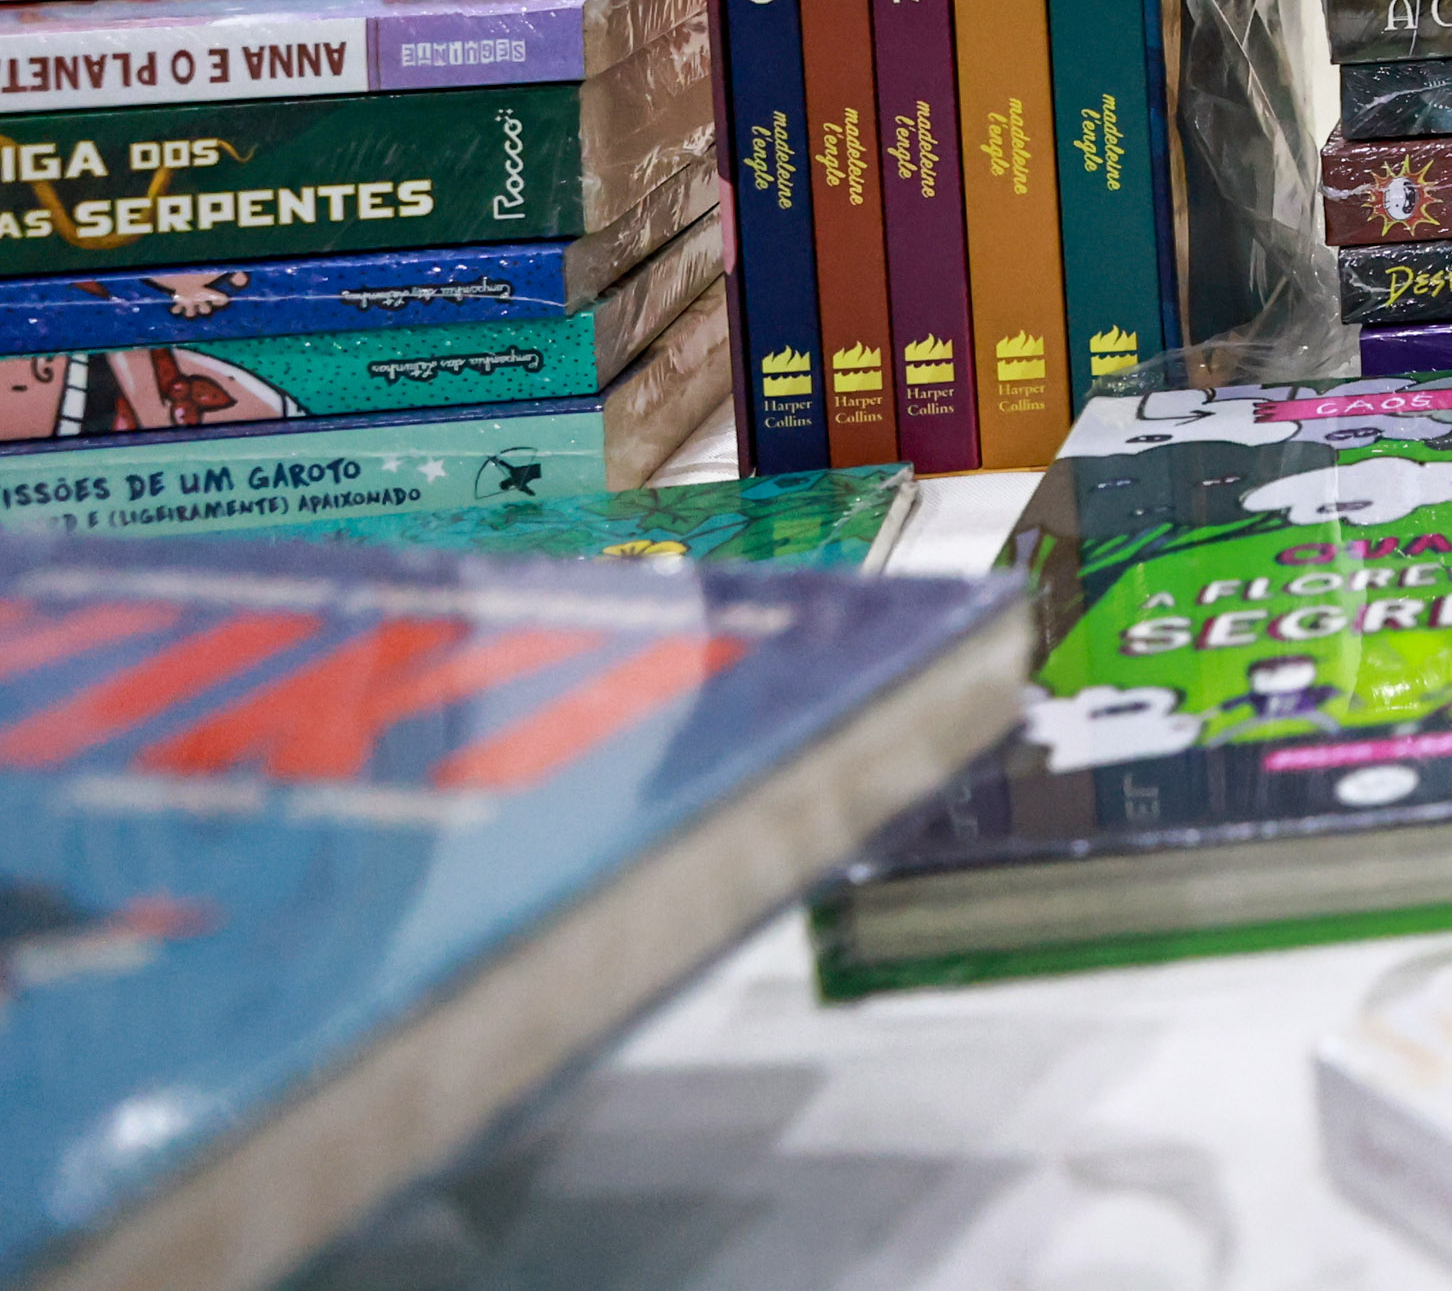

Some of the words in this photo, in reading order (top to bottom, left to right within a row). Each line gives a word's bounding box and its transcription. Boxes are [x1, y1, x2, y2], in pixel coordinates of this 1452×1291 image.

[173, 49, 194, 83] O
[212, 48, 229, 80] E
[247, 42, 347, 84] ANNA
[400, 38, 526, 67] SEGUINTE
[130, 139, 218, 170] DOS
[917, 101, 935, 198] madeleine
[75, 179, 434, 236] SERPENTES
[907, 387, 954, 402] Harper
[908, 400, 954, 416] Collins
[1315, 393, 1434, 419] CAOS
[125, 463, 173, 499] DE
[181, 459, 233, 495] UM
[247, 456, 361, 491] GAROTO
[107, 495, 288, 528] (LIGEIRAMENTE)
[298, 485, 421, 513] APAIXONADO
